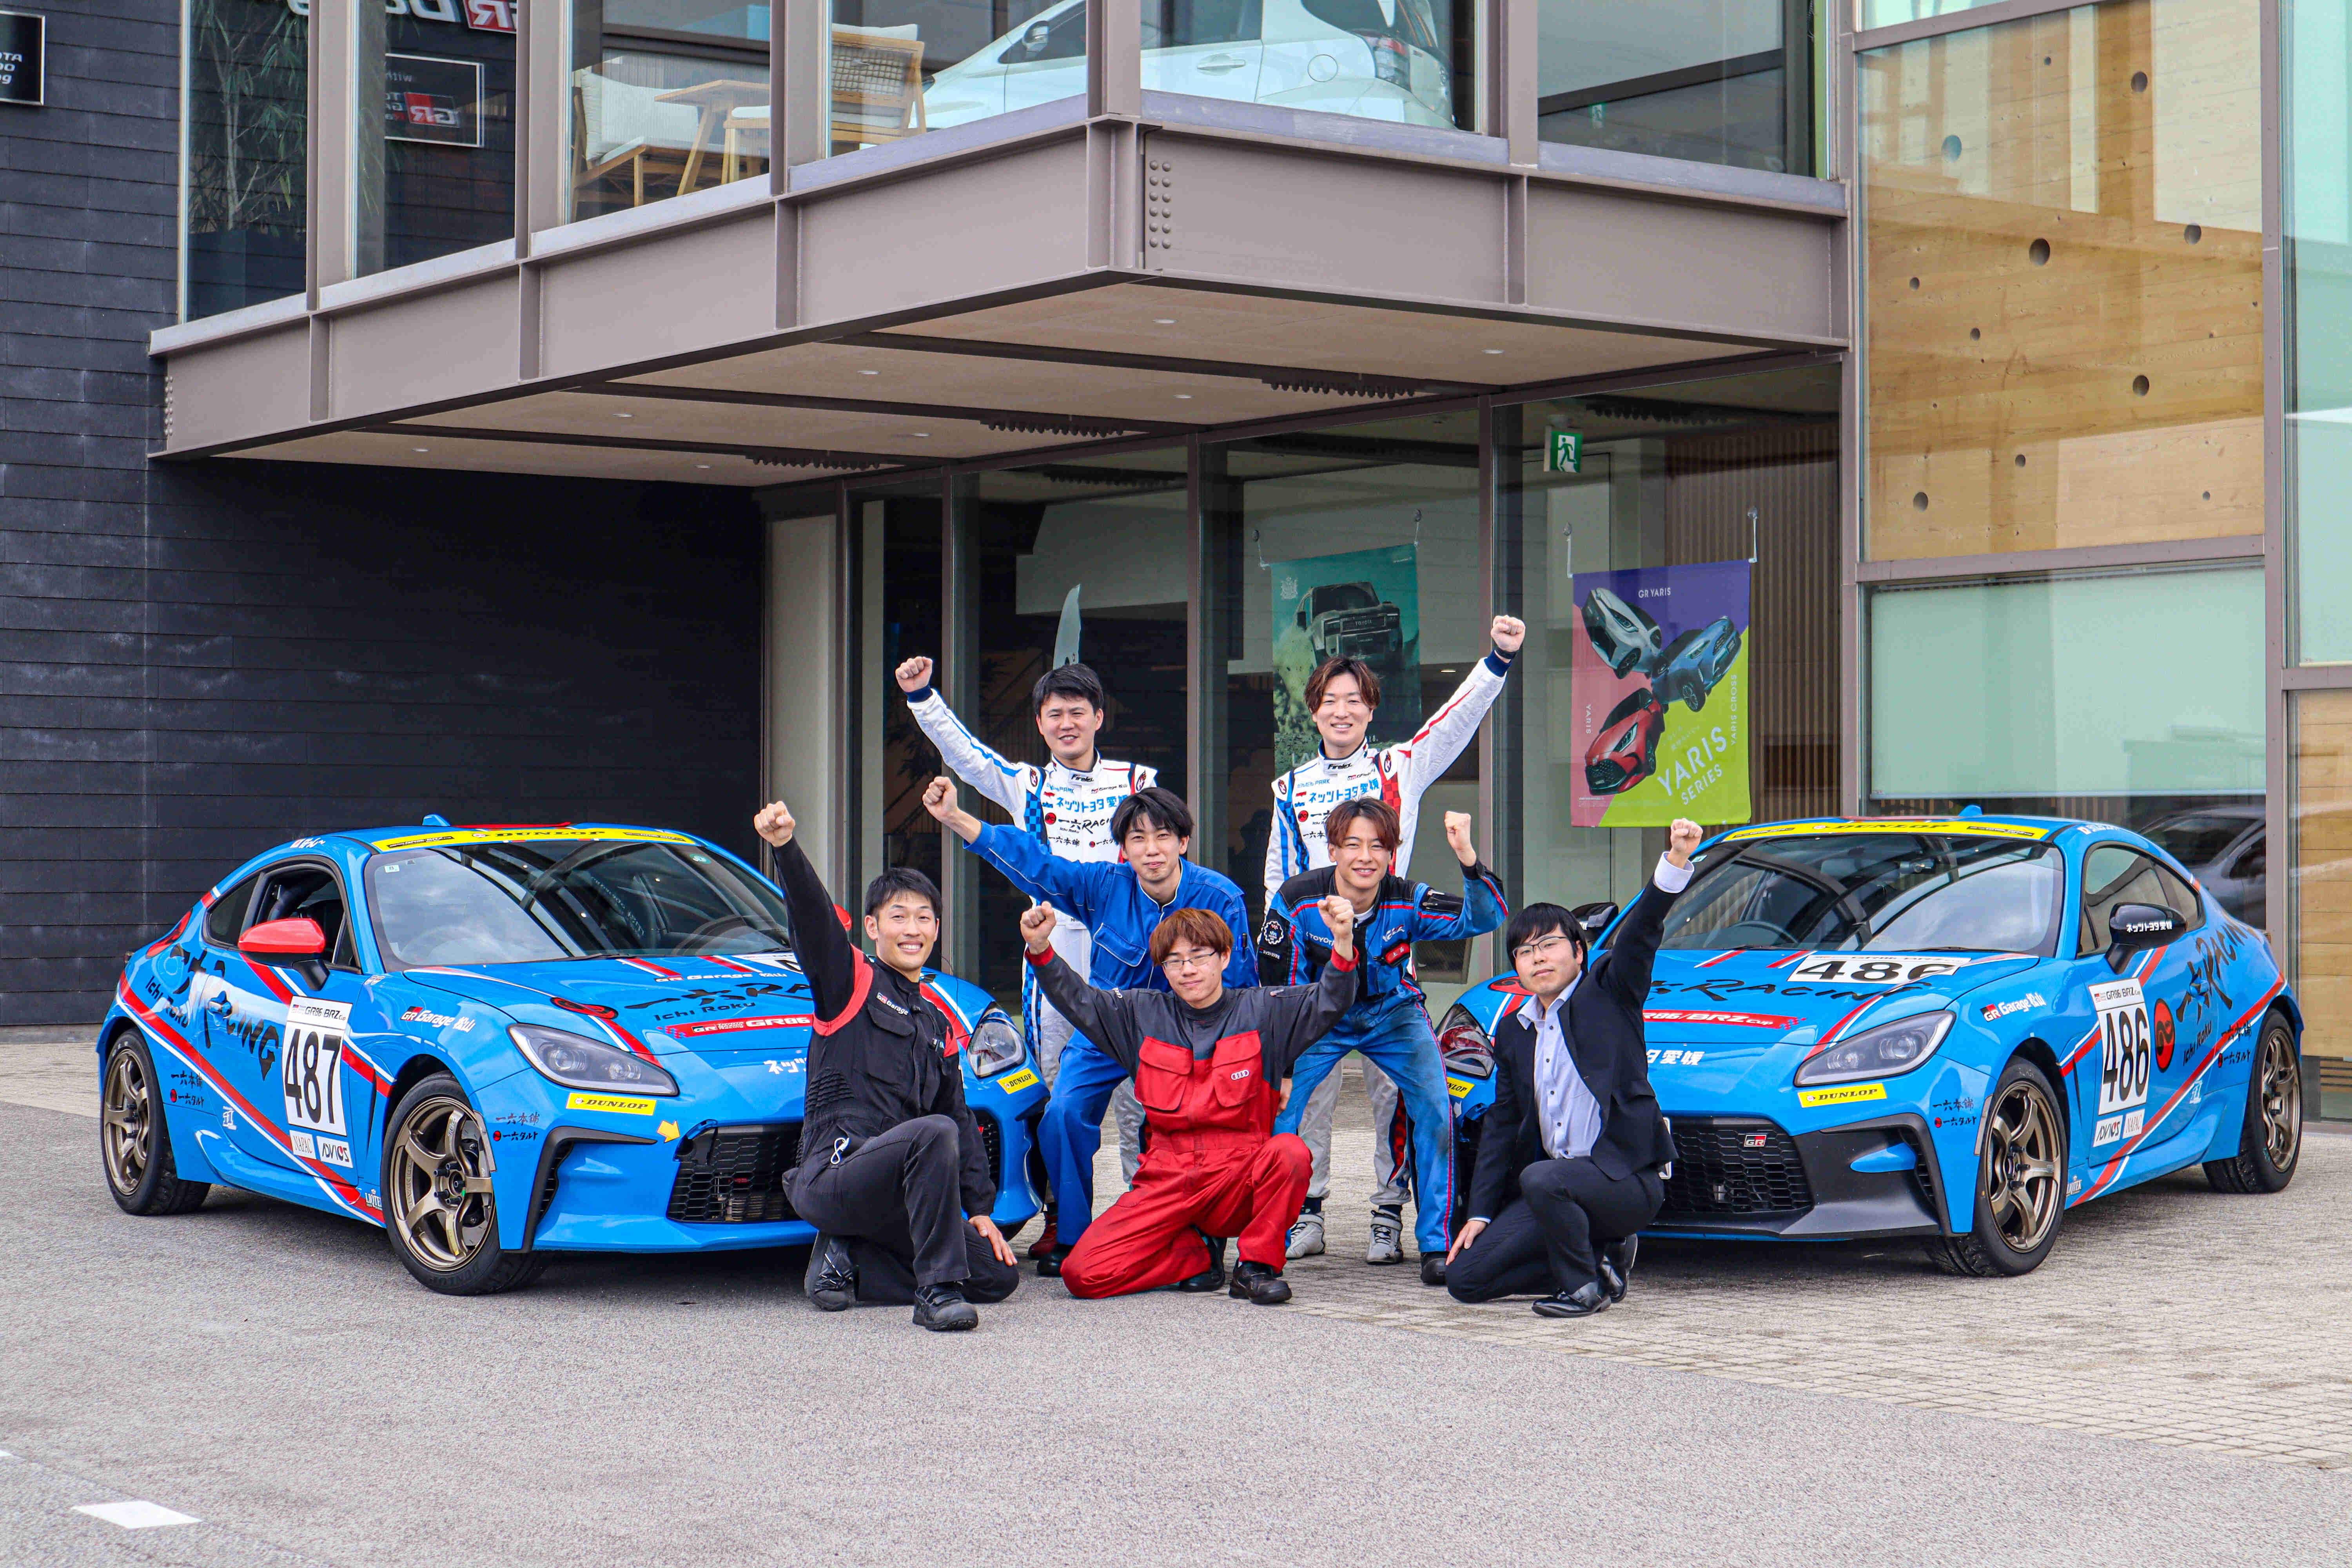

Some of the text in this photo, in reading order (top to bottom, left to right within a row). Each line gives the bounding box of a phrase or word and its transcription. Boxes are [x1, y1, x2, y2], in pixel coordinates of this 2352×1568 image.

[1638, 587, 1671, 598] GR YARIS
[1657, 726, 1727, 796] YARIS
[1681, 764, 1723, 805] SERIES
[2126, 921, 2172, 933] ネッツトヨタ愛媛
[653, 1002, 756, 1021] Ichi Roku
[886, 1000, 909, 1016] Garage
[1984, 1009, 2001, 1022] GR
[1998, 998, 2031, 1015] Garage
[401, 1011, 418, 1021] GR
[414, 1010, 455, 1028] Garage
[746, 1017, 811, 1027] GR86
[2102, 1007, 2149, 1103] 486
[2223, 1050, 2251, 1064] 一六タルト
[285, 1029, 341, 1124] 487
[1009, 1073, 1033, 1087] DUNLOP
[1447, 1082, 1468, 1092] NLOP
[1818, 1088, 1878, 1100] DUNLOP
[178, 1093, 204, 1108] 一六タルト
[586, 1099, 648, 1110] DUNLOP
[1932, 1097, 1974, 1112] 一六本舗
[496, 1111, 541, 1126] 一六本舗
[1943, 1116, 1977, 1126] 一六タルト
[2126, 1114, 2143, 1133] NAPAC
[503, 1131, 538, 1141] 一六タルト
[1744, 1136, 1766, 1146] GR
[293, 1135, 313, 1154] NAPAC
[365, 1192, 382, 1207] LIQTE
